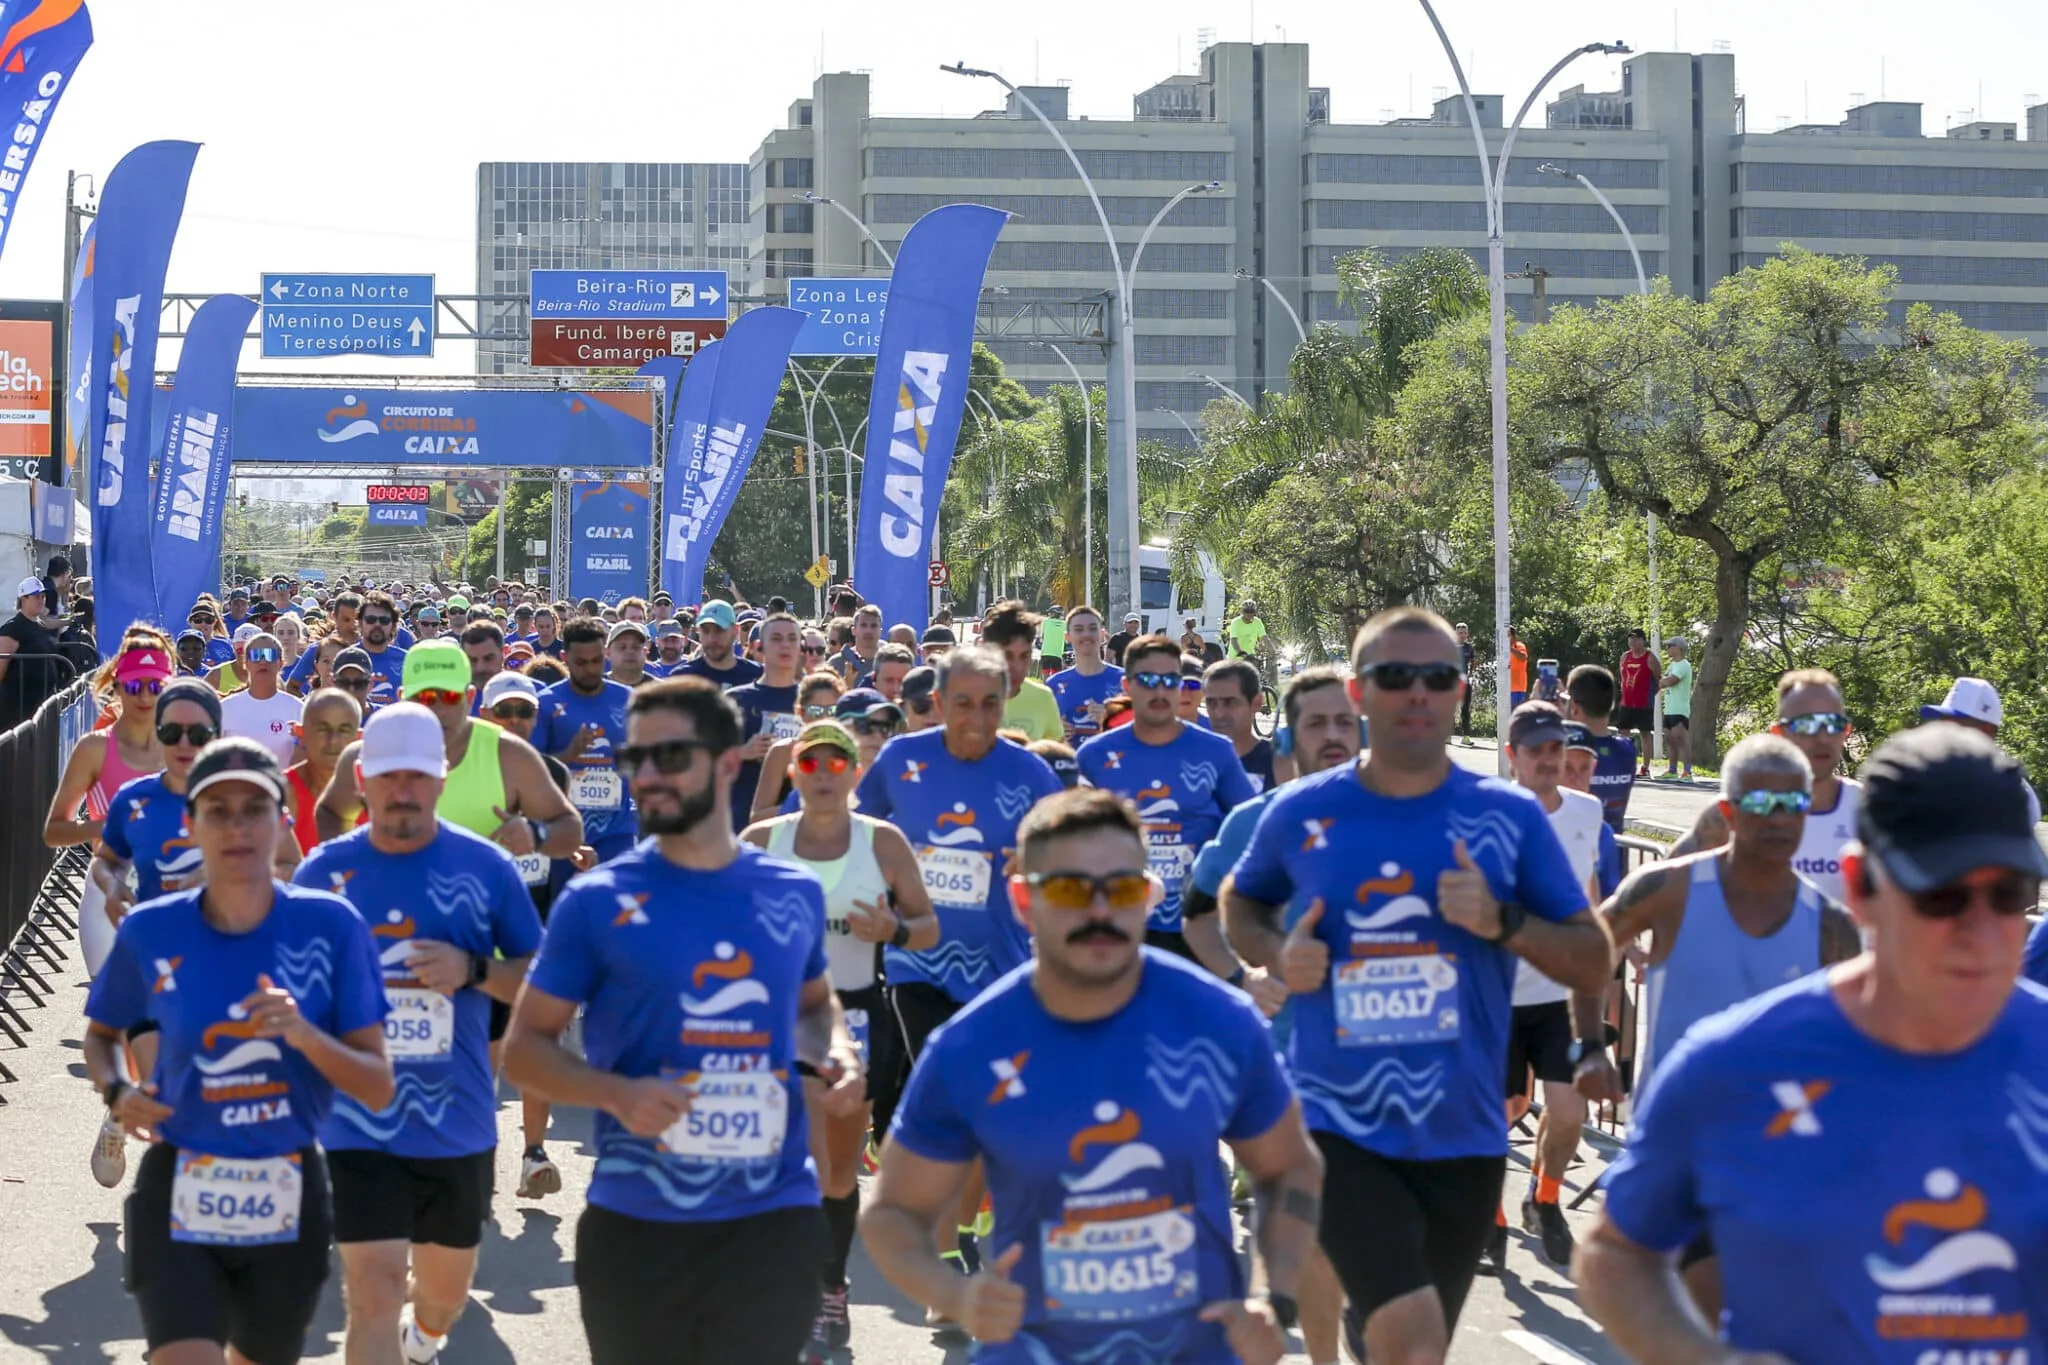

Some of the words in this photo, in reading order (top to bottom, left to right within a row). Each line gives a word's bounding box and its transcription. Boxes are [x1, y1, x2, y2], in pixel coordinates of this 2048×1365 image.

[294, 282, 344, 298] Zona
[351, 282, 409, 298] Norte
[577, 279, 666, 294] Beira-Rio
[796, 287, 845, 303] Zona
[536, 299, 600, 312] Beira-Rio
[607, 299, 666, 312] Stadium
[268, 313, 344, 329] Menino
[352, 313, 402, 329] Deus
[820, 309, 870, 325] Zona
[555, 324, 607, 340] Fund.
[616, 325, 666, 340] Iberê
[280, 334, 402, 351] Teresópolis
[578, 344, 666, 362] Camargo
[98, 294, 142, 506] CAIXA
[383, 406, 437, 416] CIRCUITO
[438, 407, 454, 416] DE
[381, 416, 477, 433] CORRIDAS
[404, 436, 480, 455] CAIXA
[880, 350, 949, 558] CAIXA
[157, 467, 172, 521] GOVERNO
[166, 412, 182, 463] FEDERAL
[168, 412, 218, 541] BRASIL
[376, 508, 419, 521] CAIXA
[585, 526, 634, 539] CAIXA
[586, 557, 632, 571] BRASIL
[580, 786, 611, 799] 5019
[517, 858, 540, 873] 90
[924, 869, 974, 892] 5065
[1349, 987, 1437, 1021] 10617
[221, 1098, 291, 1128] CAIXA
[686, 1110, 762, 1139] 5091
[197, 1191, 276, 1220] 5046
[1059, 1250, 1176, 1295] 10615
